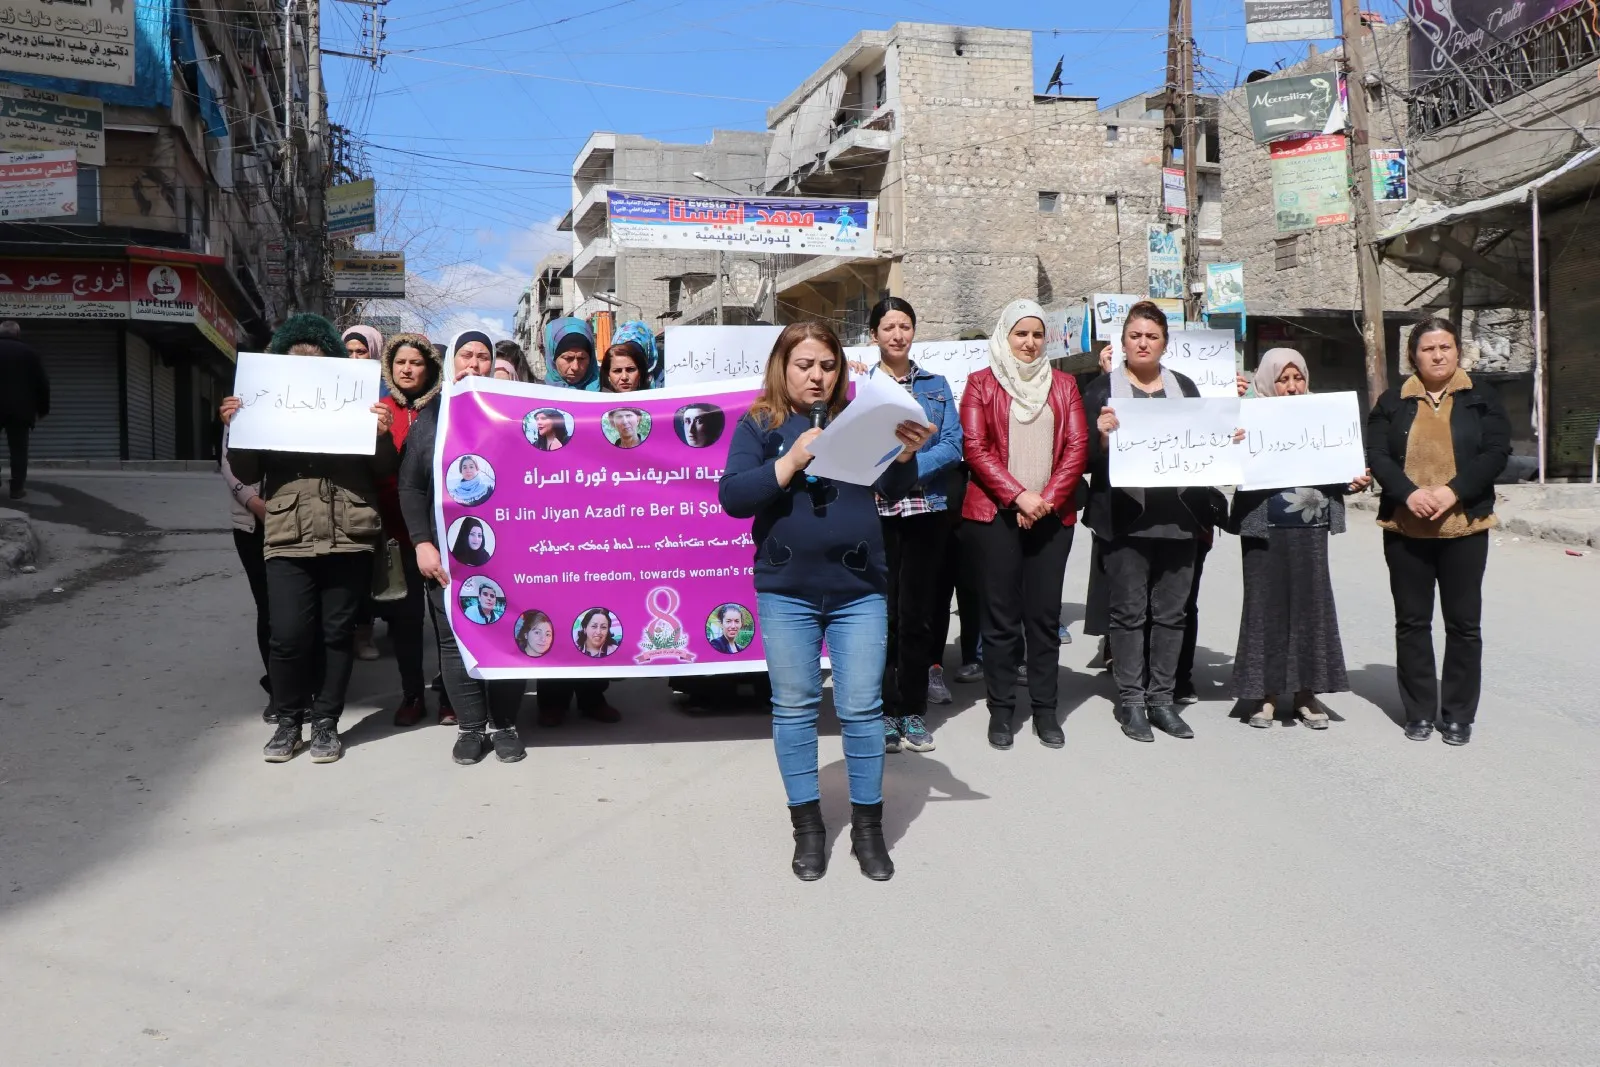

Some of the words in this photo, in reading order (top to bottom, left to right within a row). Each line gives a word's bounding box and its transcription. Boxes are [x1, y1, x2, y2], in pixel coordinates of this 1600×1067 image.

[1488, 1, 1526, 32] Center
[30, 35, 66, 49] الأسنان
[67, 41, 88, 52] طب
[89, 42, 100, 57] في
[102, 46, 129, 57] دكتور
[1450, 28, 1485, 58] Beauty
[23, 50, 44, 60] وجسور
[45, 52, 65, 62] تيجان
[8, 100, 48, 117] حسن
[1252, 91, 1313, 108] Marsilizy
[54, 107, 88, 128] ليلى
[8, 167, 43, 177] محمد
[755, 209, 815, 228] معهد
[695, 231, 746, 243] التعليمية
[750, 232, 791, 245] للدورات
[21, 272, 63, 291] عمو
[1182, 342, 1191, 358] 8
[274, 385, 322, 413] الحياة
[319, 374, 364, 412] المرأة
[1116, 430, 1147, 452] سوريا
[1180, 429, 1207, 450] شمال
[523, 467, 570, 489] المرأة
[575, 466, 607, 488] ثورة
[495, 508, 510, 522] Bi
[514, 507, 536, 521] Jin
[541, 505, 579, 523] Jiyan
[585, 504, 626, 519] Azadî
[630, 506, 645, 517] re
[650, 503, 675, 517] Ber
[680, 502, 694, 516] Bi
[698, 501, 723, 519] Şor
[513, 572, 558, 584] Woman
[562, 571, 580, 583] life
[584, 569, 636, 582] freedom,
[640, 567, 686, 580] towards
[689, 565, 740, 578] woman's
